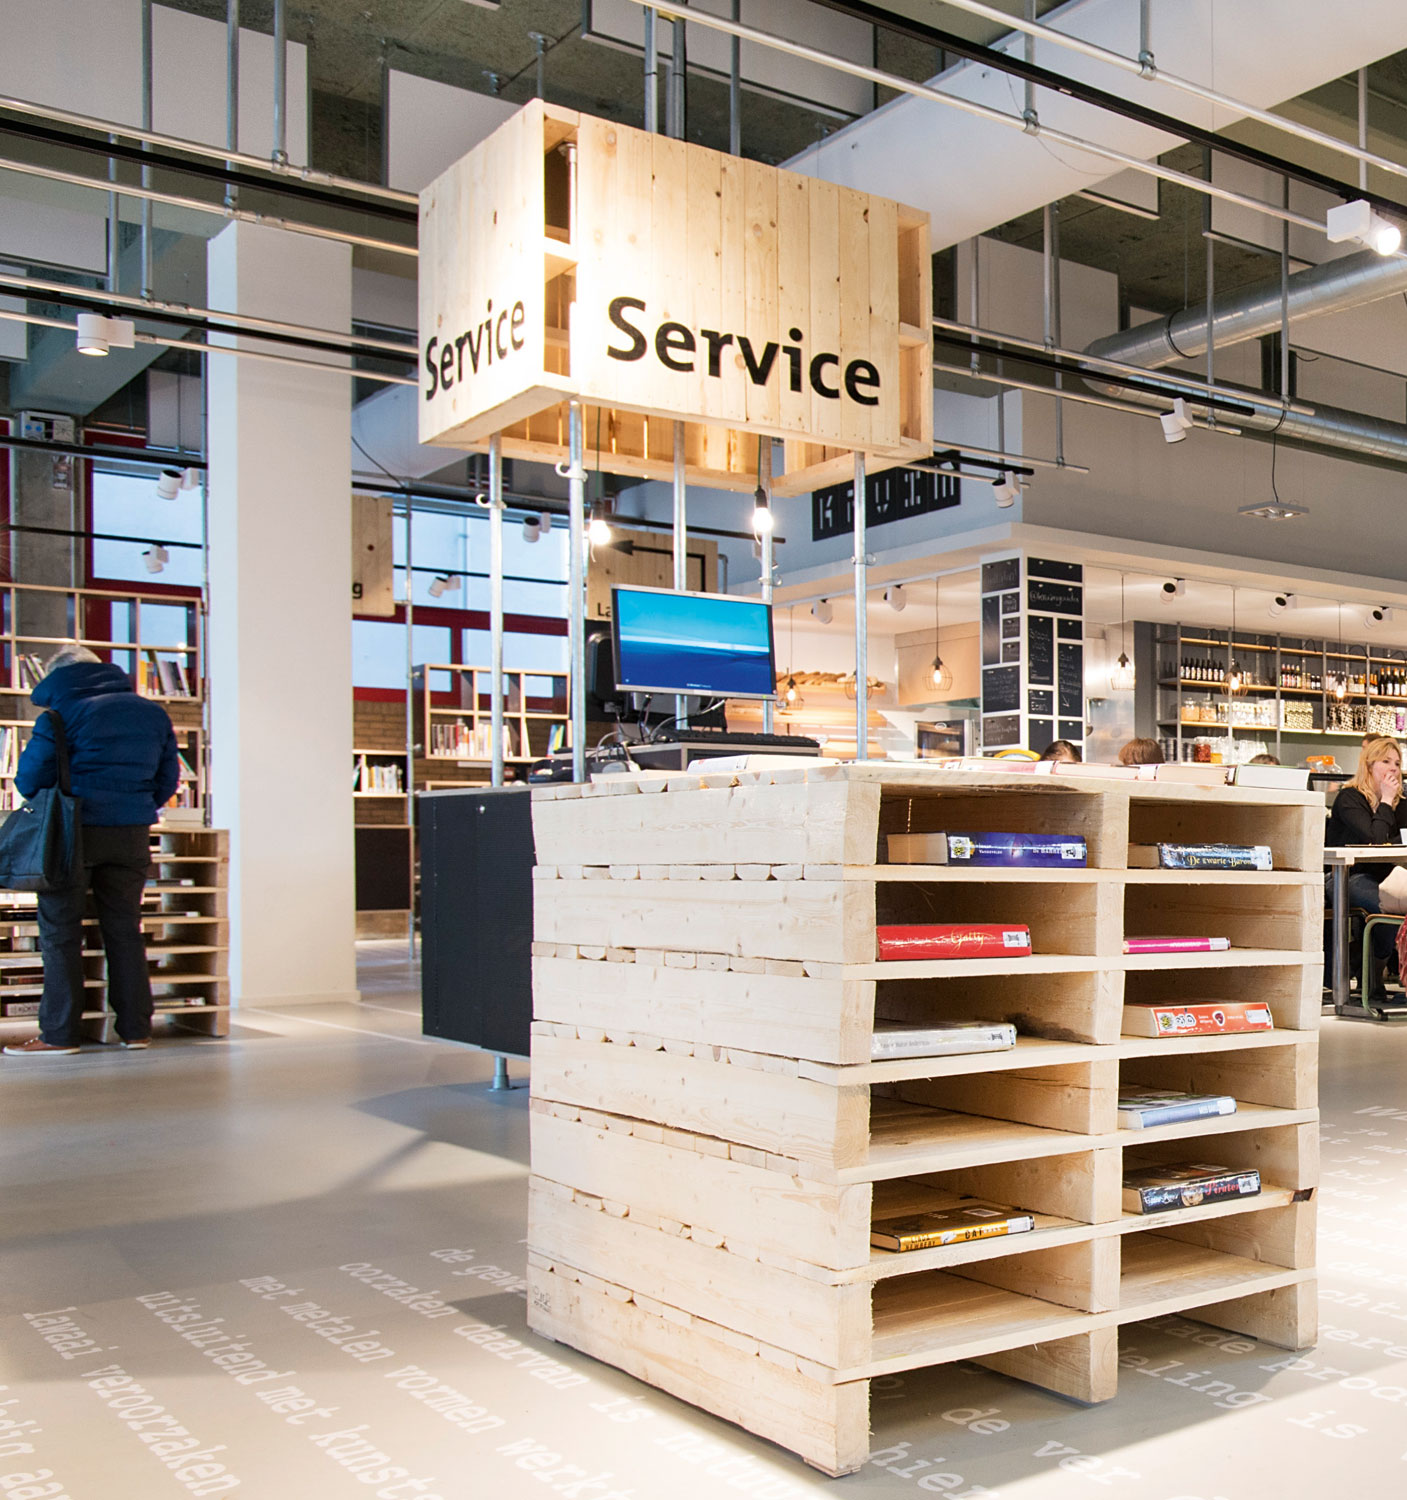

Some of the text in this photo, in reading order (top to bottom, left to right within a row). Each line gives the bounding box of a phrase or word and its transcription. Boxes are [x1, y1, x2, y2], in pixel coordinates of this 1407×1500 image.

[425, 298, 525, 401] Service
[606, 296, 881, 407] Service
[238, 1275, 304, 1301] met
[279, 1301, 396, 1363] metalen
[383, 1364, 507, 1434] vormen
[338, 1261, 460, 1319] oorzaken
[452, 1322, 590, 1389] daarvan
[23, 1306, 242, 1497] lawaai veroorzaken
[136, 1291, 446, 1500] uitsluitend met kunst
[941, 1407, 1011, 1435] de
[1118, 1347, 1273, 1409] eling
[1286, 1409, 1369, 1440] is
